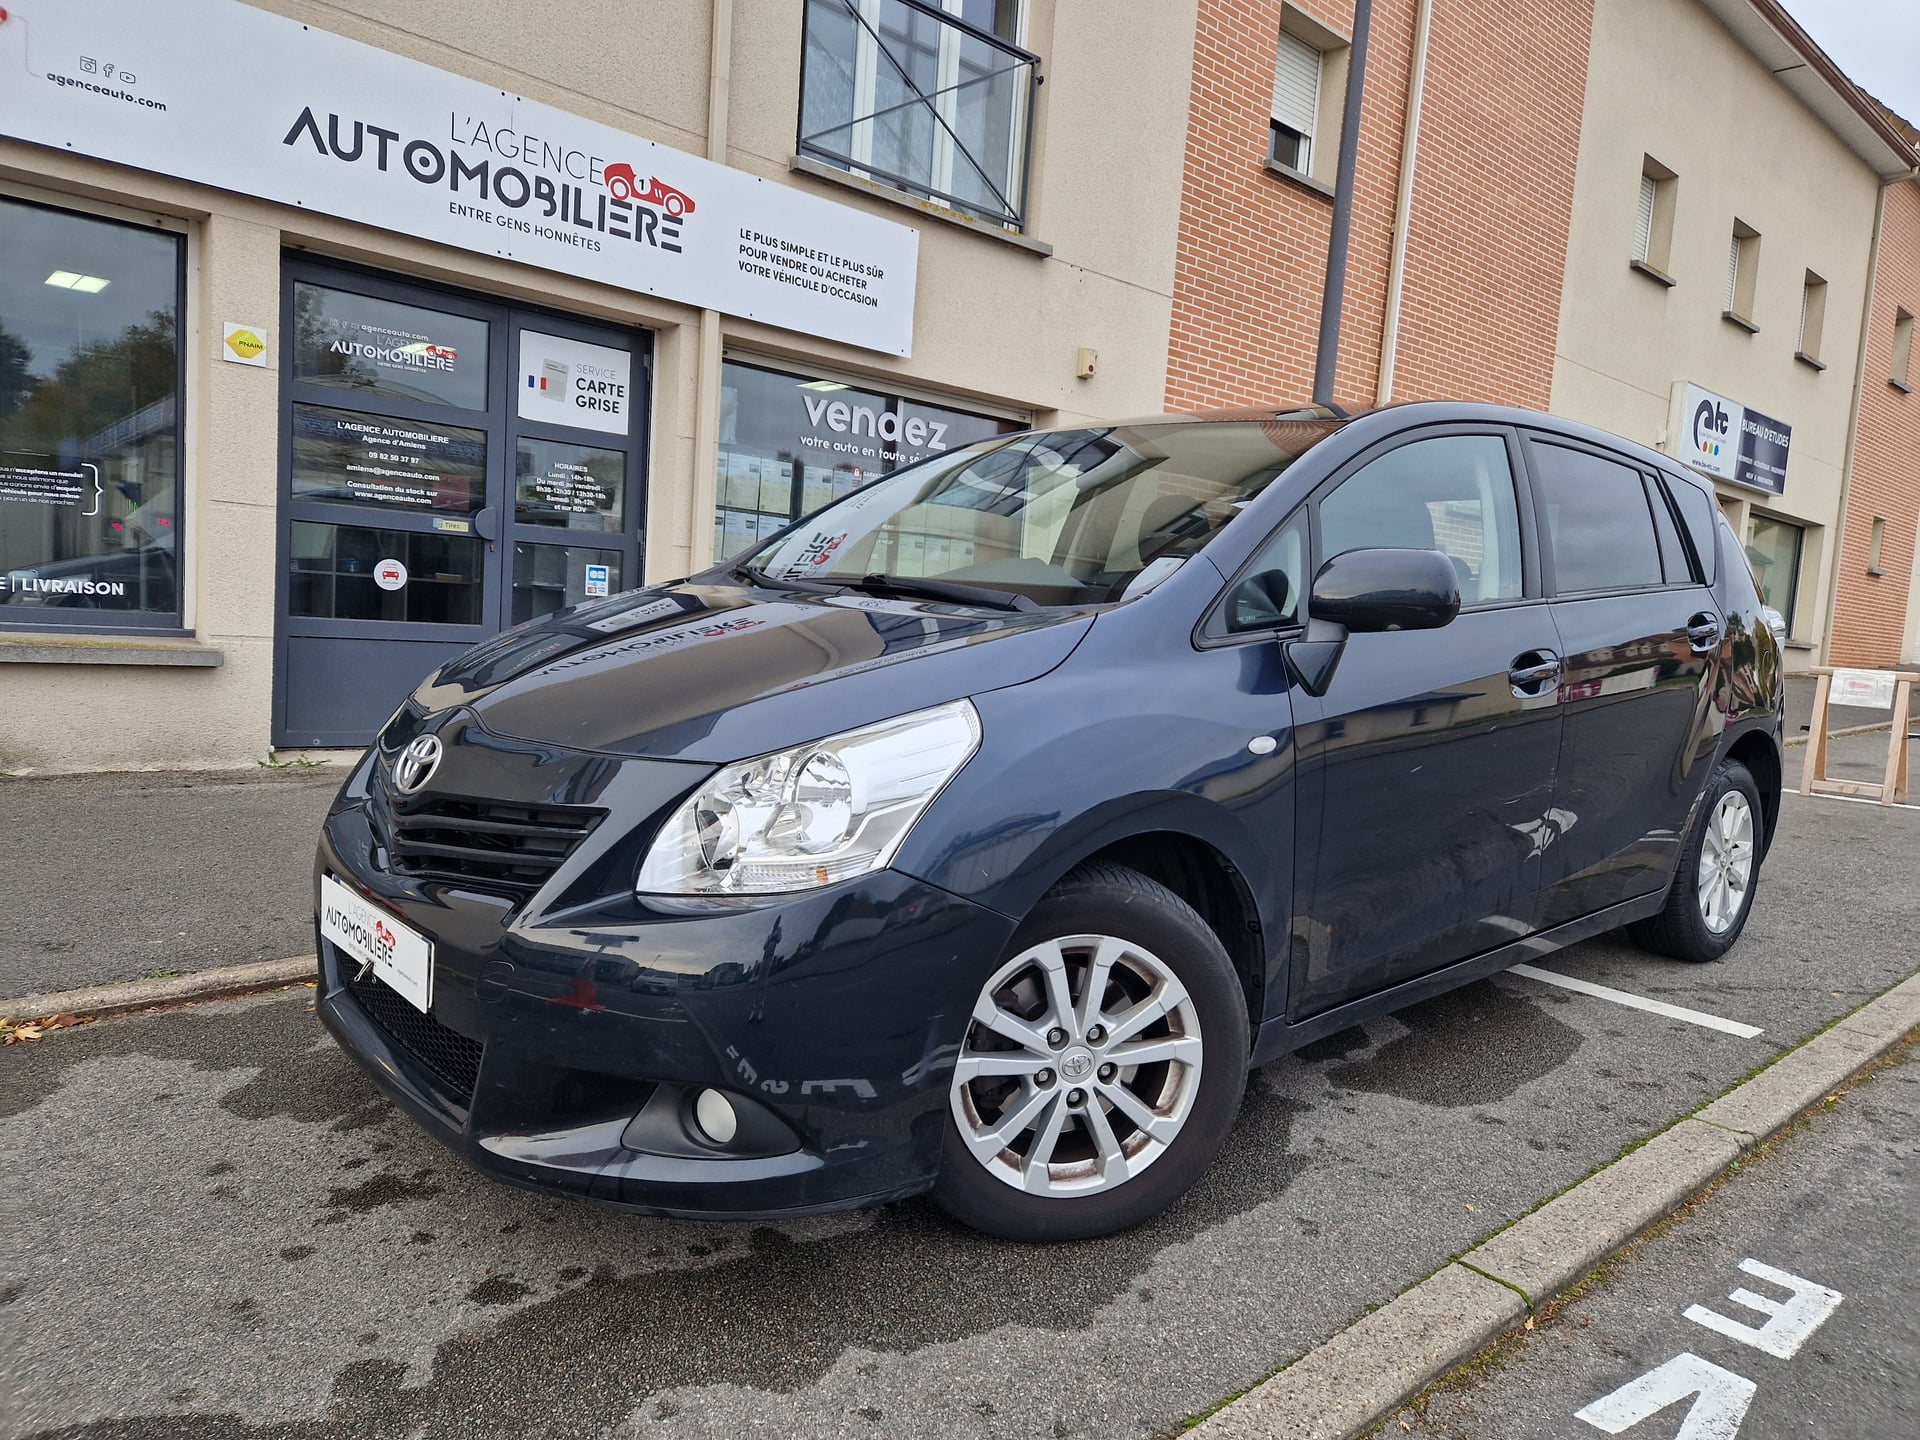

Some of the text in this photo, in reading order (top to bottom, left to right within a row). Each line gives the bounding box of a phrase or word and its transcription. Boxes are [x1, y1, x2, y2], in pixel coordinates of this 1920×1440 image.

[46, 72, 167, 112] agenceauto.com
[451, 112, 604, 186] L'AGENCE
[449, 202, 601, 252] ENTRE GENS HONNÊTES
[739, 228, 751, 241] LE
[753, 232, 778, 248] PLUS
[780, 240, 815, 260] SIMPLE
[817, 251, 829, 264] ET
[830, 255, 840, 267] LE
[842, 259, 865, 274] PLUS
[739, 244, 868, 290] POUR VENDRE OU ACHETER
[738, 260, 878, 308] VOTRE VÉHICULE D'OCCASION
[361, 324, 429, 341] agenceauto.com
[576, 363, 616, 380] SERVICE
[575, 377, 625, 398] CARTE
[575, 395, 620, 414] GRISE
[337, 421, 449, 444] L'AGENCE AUTOMOBILIERE
[803, 395, 951, 451] vendez
[1742, 418, 1764, 439] BUREAU
[362, 435, 427, 450] Agence d'Amiens
[800, 435, 830, 449] votre
[833, 442, 859, 454] auto
[861, 448, 875, 457] en
[878, 449, 906, 462] toute
[346, 464, 440, 481] amiens@agenceauto.com
[547, 471, 566, 479] Lundi
[554, 462, 588, 473] HORAIRES
[346, 481, 393, 492] Consultation
[406, 487, 425, 496] stock
[536, 477, 546, 485] Du
[546, 479, 565, 487] mardi
[574, 483, 601, 491] vendredi
[354, 490, 432, 505] www.agenceauto.com
[572, 505, 587, 513] RDV
[22, 577, 125, 596] LIVRAISON
